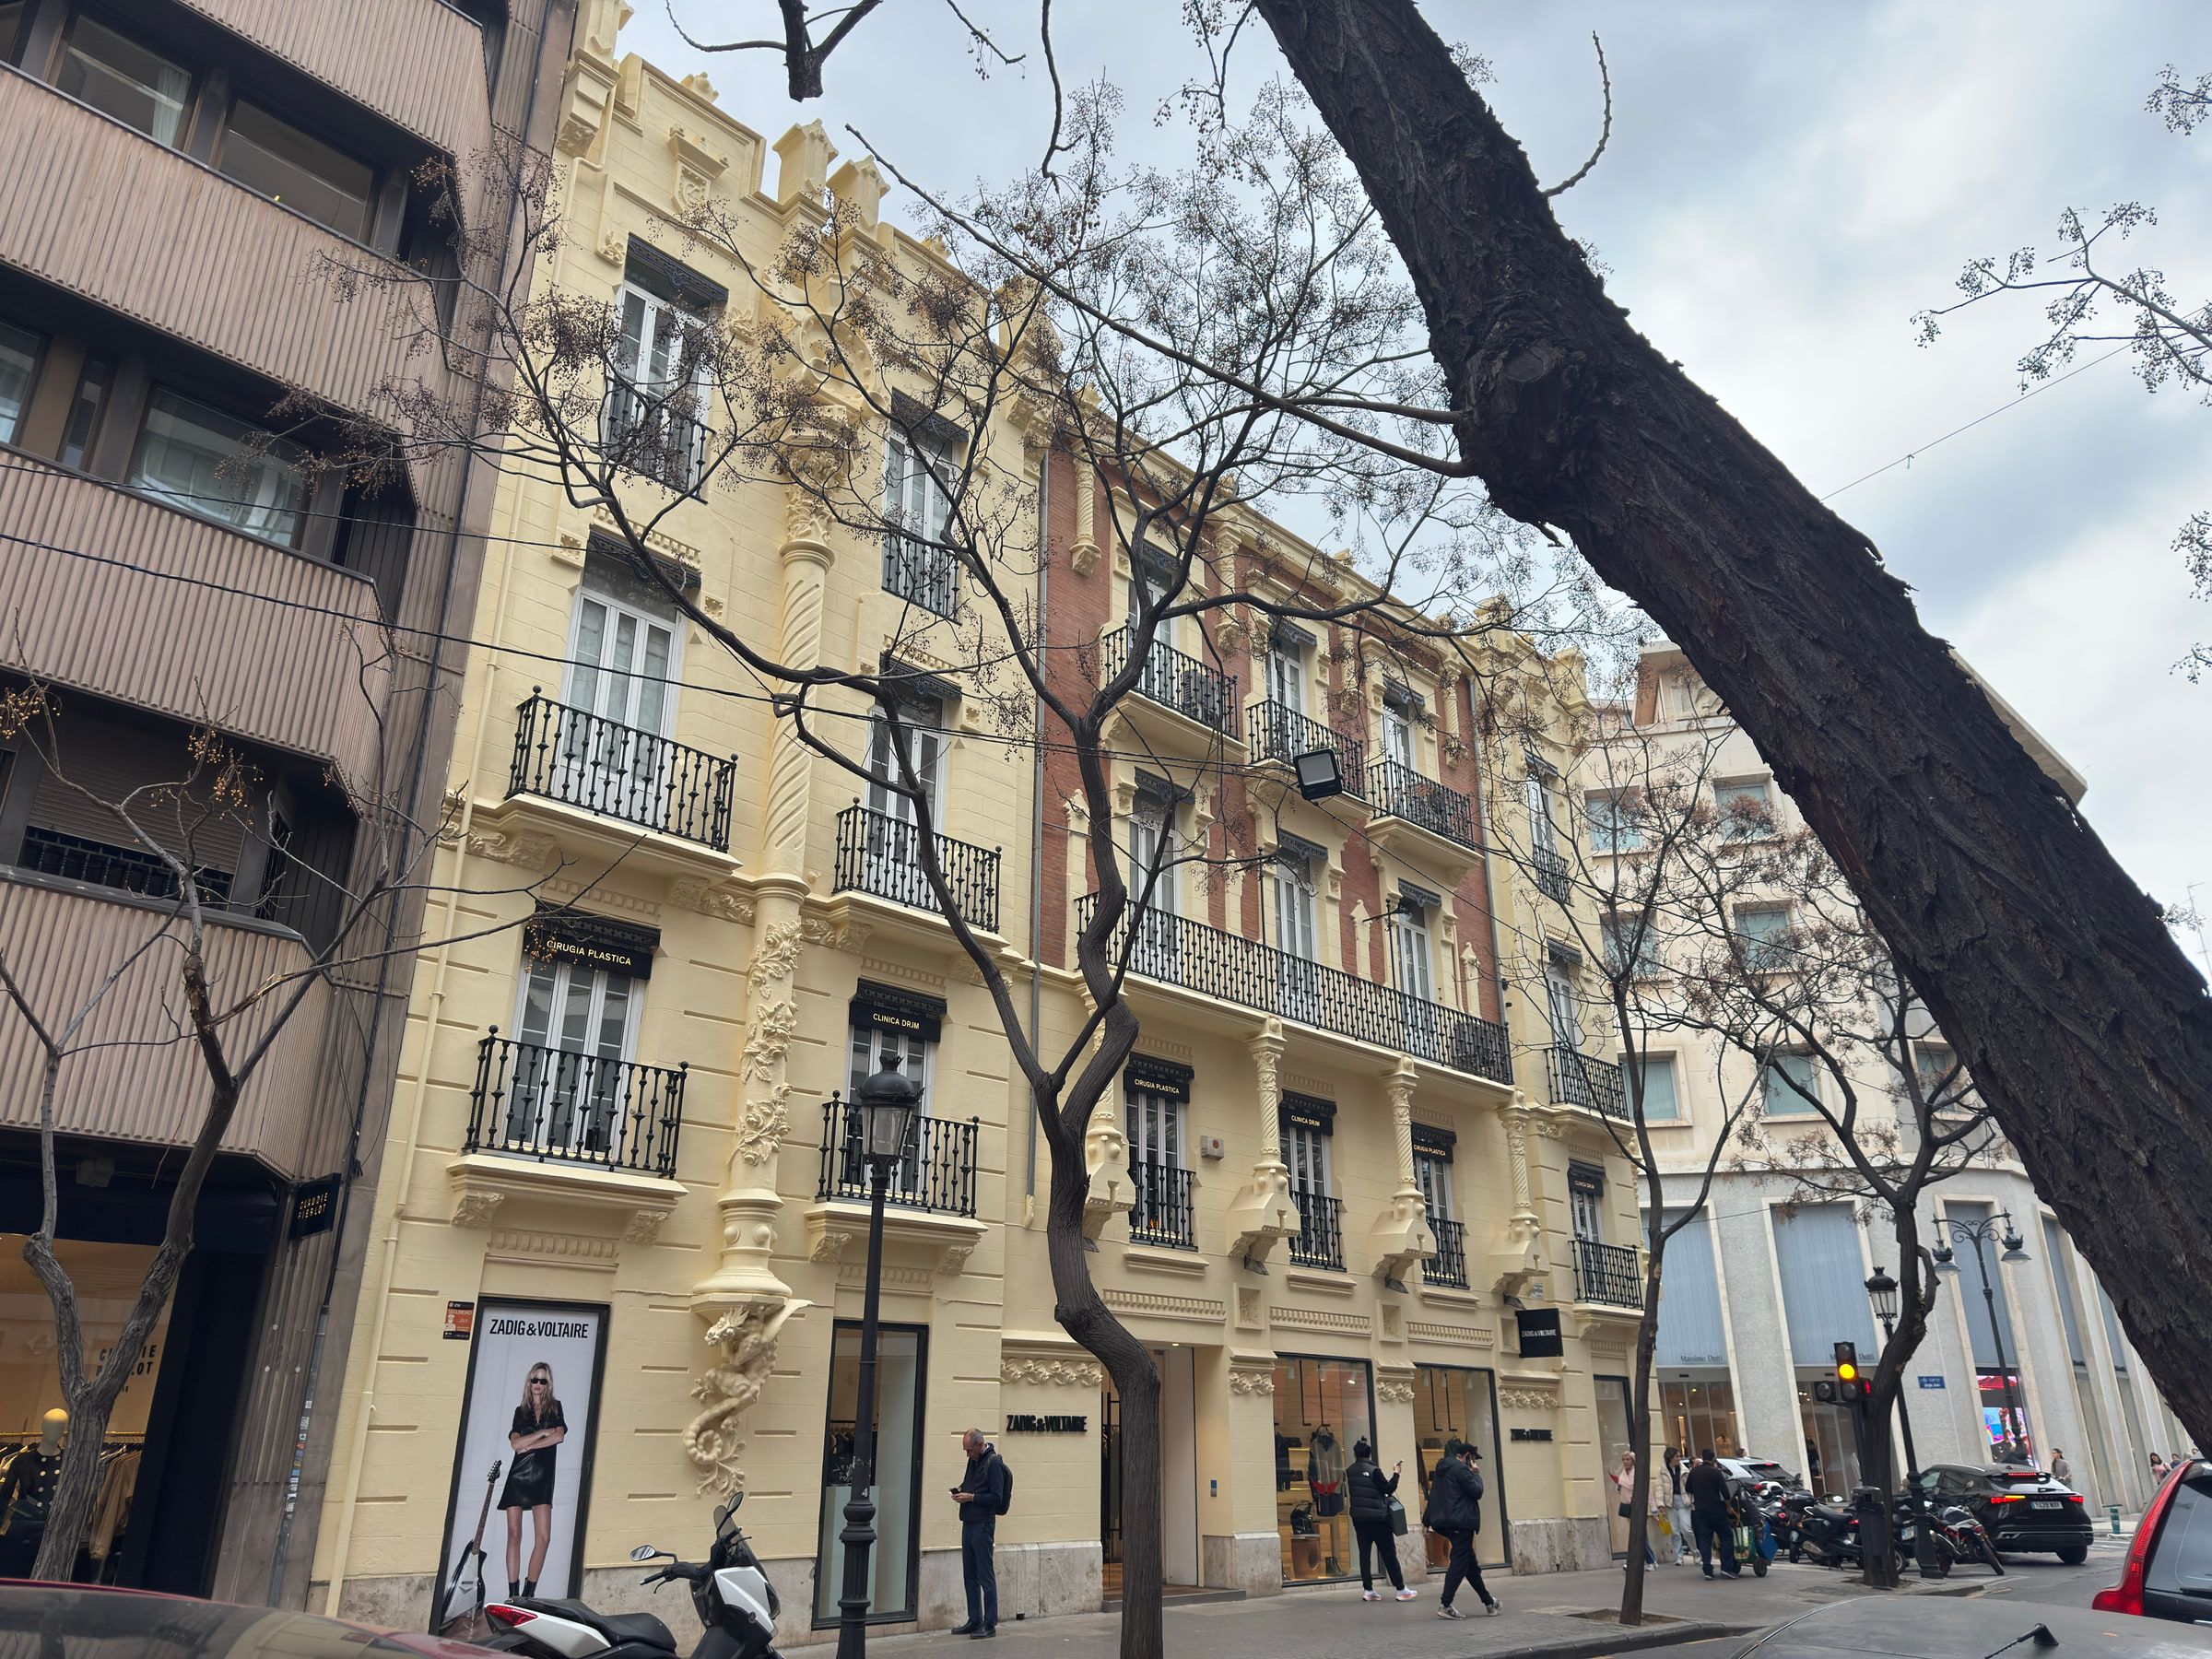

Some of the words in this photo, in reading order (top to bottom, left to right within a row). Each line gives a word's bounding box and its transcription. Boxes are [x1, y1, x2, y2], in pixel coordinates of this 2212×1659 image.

[547, 940, 585, 956] CIRUGIA
[587, 949, 631, 966] PLASTICA
[873, 1013, 900, 1026] CLINICA
[901, 1019, 920, 1030] DRJM
[1135, 1078, 1156, 1088] CIRUGIA
[1156, 1083, 1180, 1094] PLASTICA
